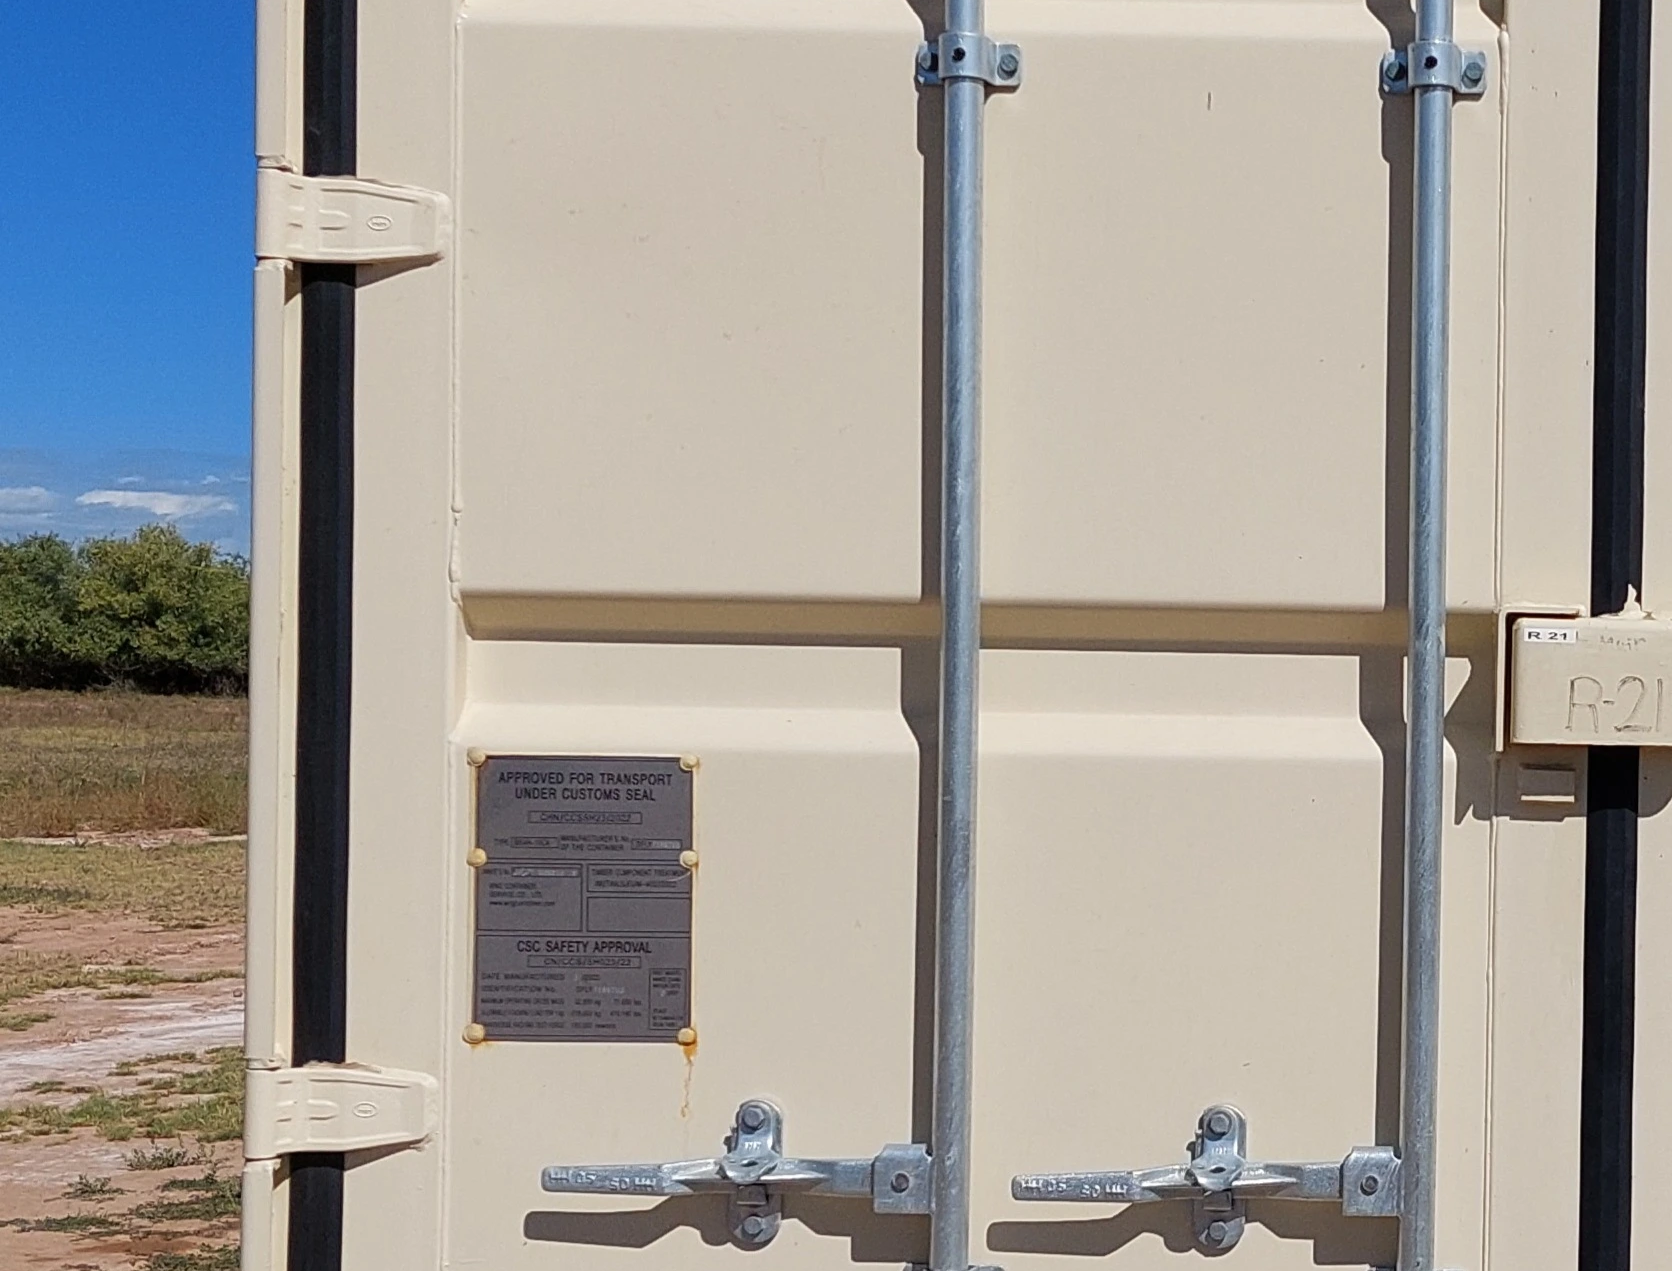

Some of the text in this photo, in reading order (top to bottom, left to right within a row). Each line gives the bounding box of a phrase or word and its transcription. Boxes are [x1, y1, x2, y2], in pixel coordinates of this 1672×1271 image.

[1527, 631, 1568, 641] R 21
[1565, 676, 1663, 733] R-21
[499, 772, 673, 786] APPROVED FOR TRANSPORT
[515, 787, 656, 801] UNDER CUSTOMS SEAL
[517, 941, 652, 953] CSC SAFETY APPROVAL
